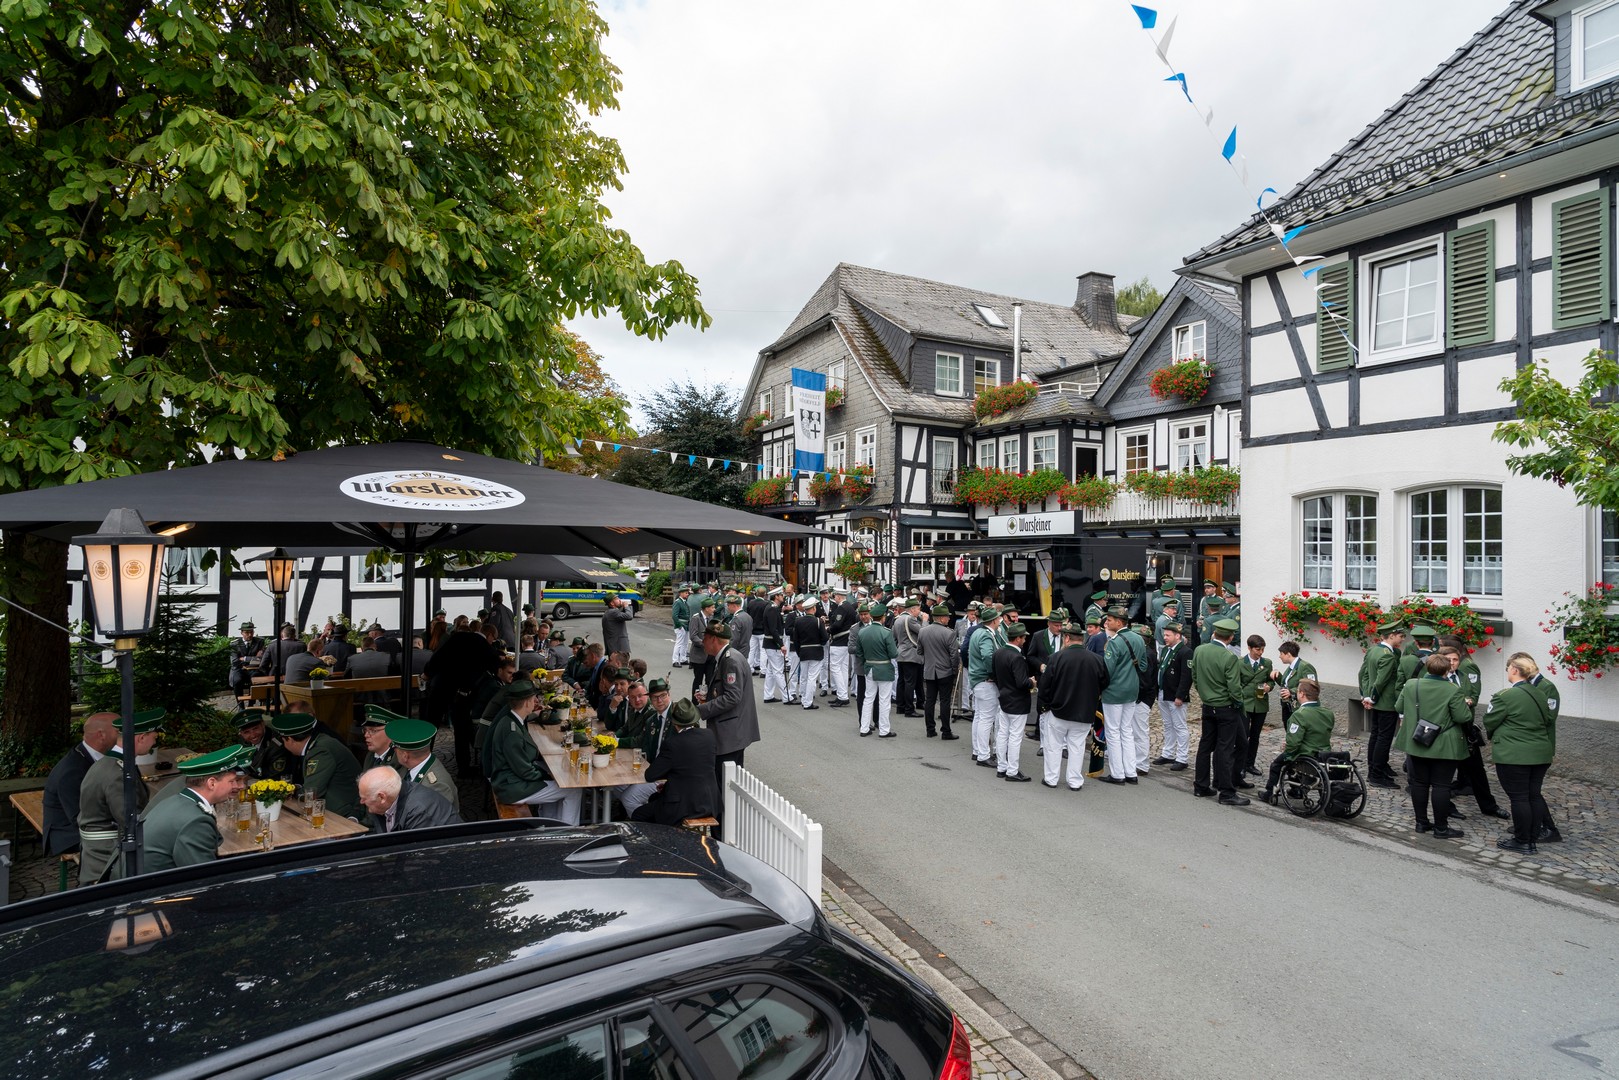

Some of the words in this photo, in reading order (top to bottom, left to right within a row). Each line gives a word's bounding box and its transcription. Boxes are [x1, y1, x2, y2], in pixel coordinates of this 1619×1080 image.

[351, 481, 515, 499] Warsteiner
[1018, 515, 1052, 534] Warsteiner
[1111, 568, 1141, 582] Warsteiner
